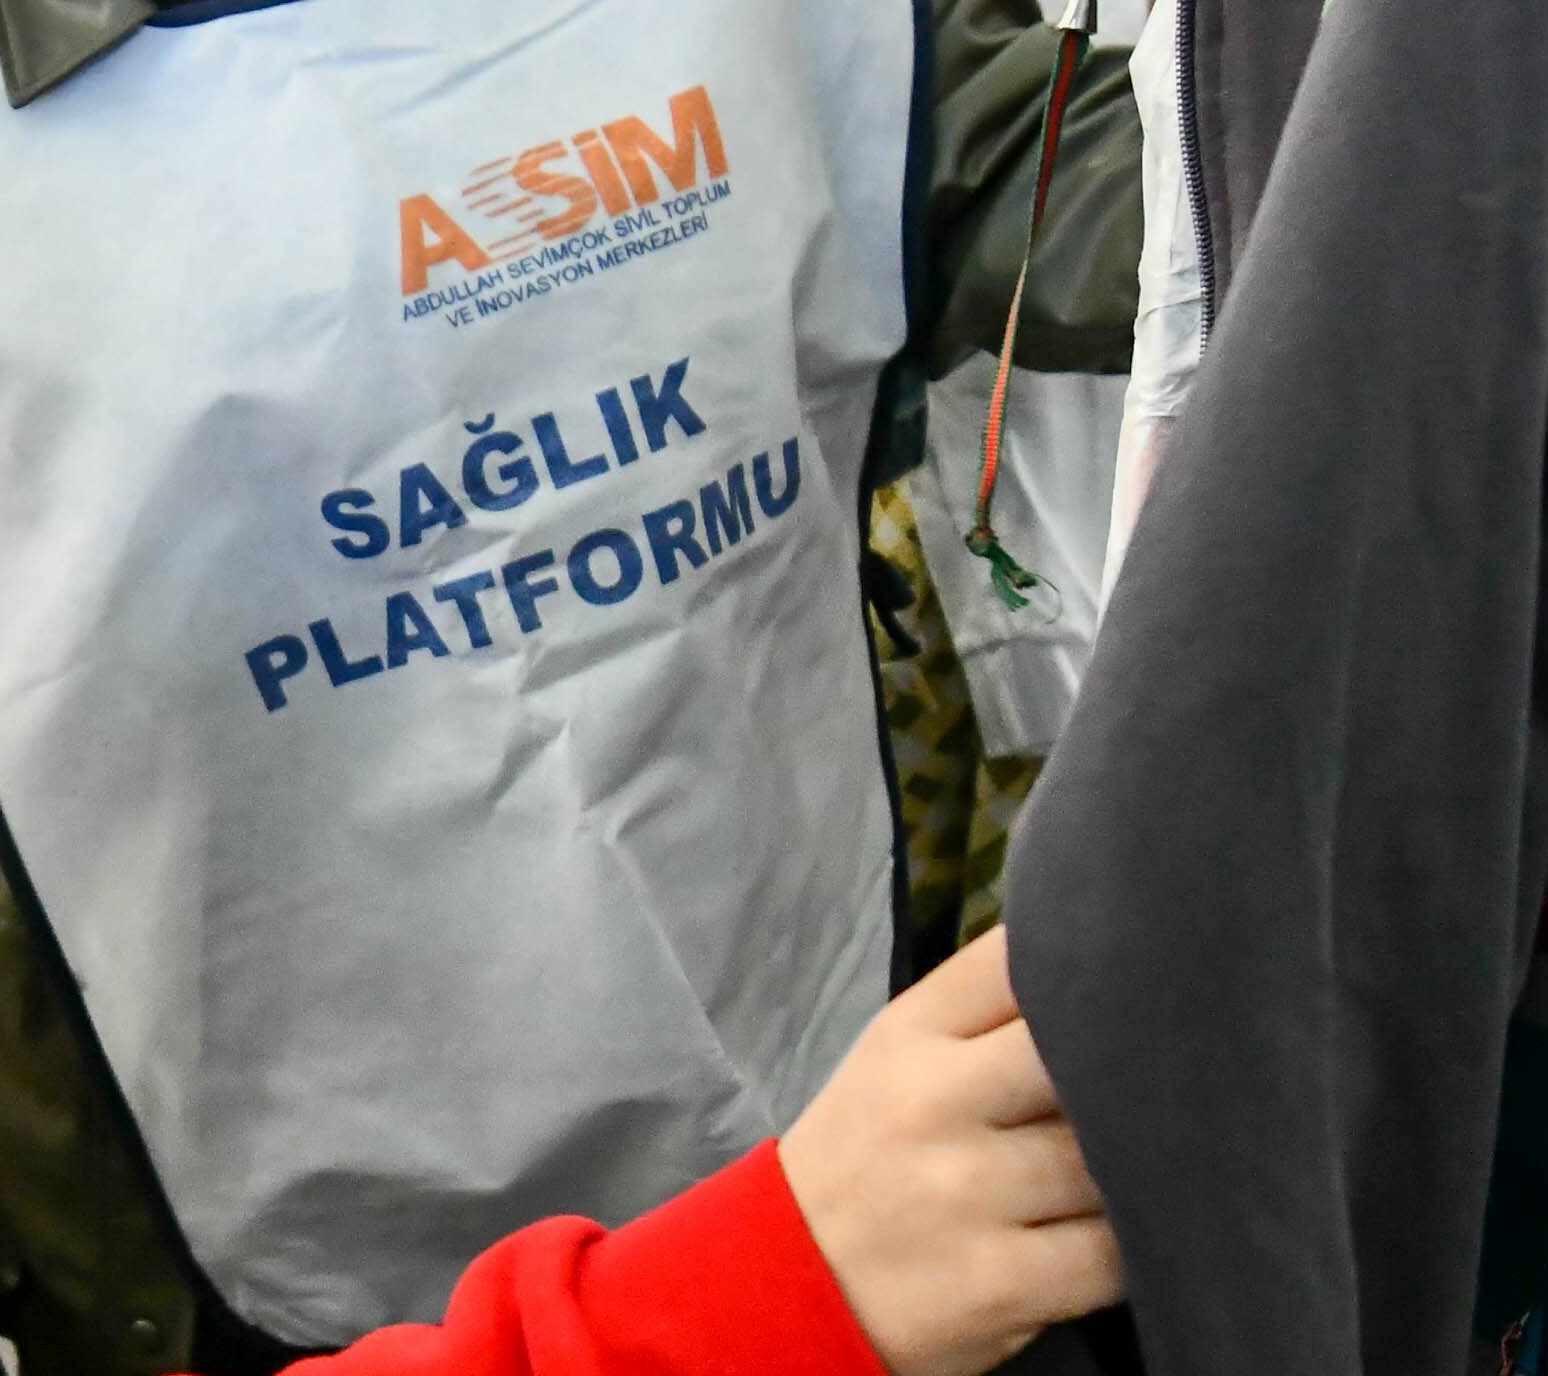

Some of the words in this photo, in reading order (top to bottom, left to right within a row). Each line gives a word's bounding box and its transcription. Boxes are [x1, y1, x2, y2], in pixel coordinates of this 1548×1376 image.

[403, 270, 504, 323] ABDULLAH
[661, 180, 732, 219] TOPLUM
[445, 306, 475, 328] VE
[320, 356, 707, 559] SAĞLIK
[244, 436, 800, 713] PLATFORMU
